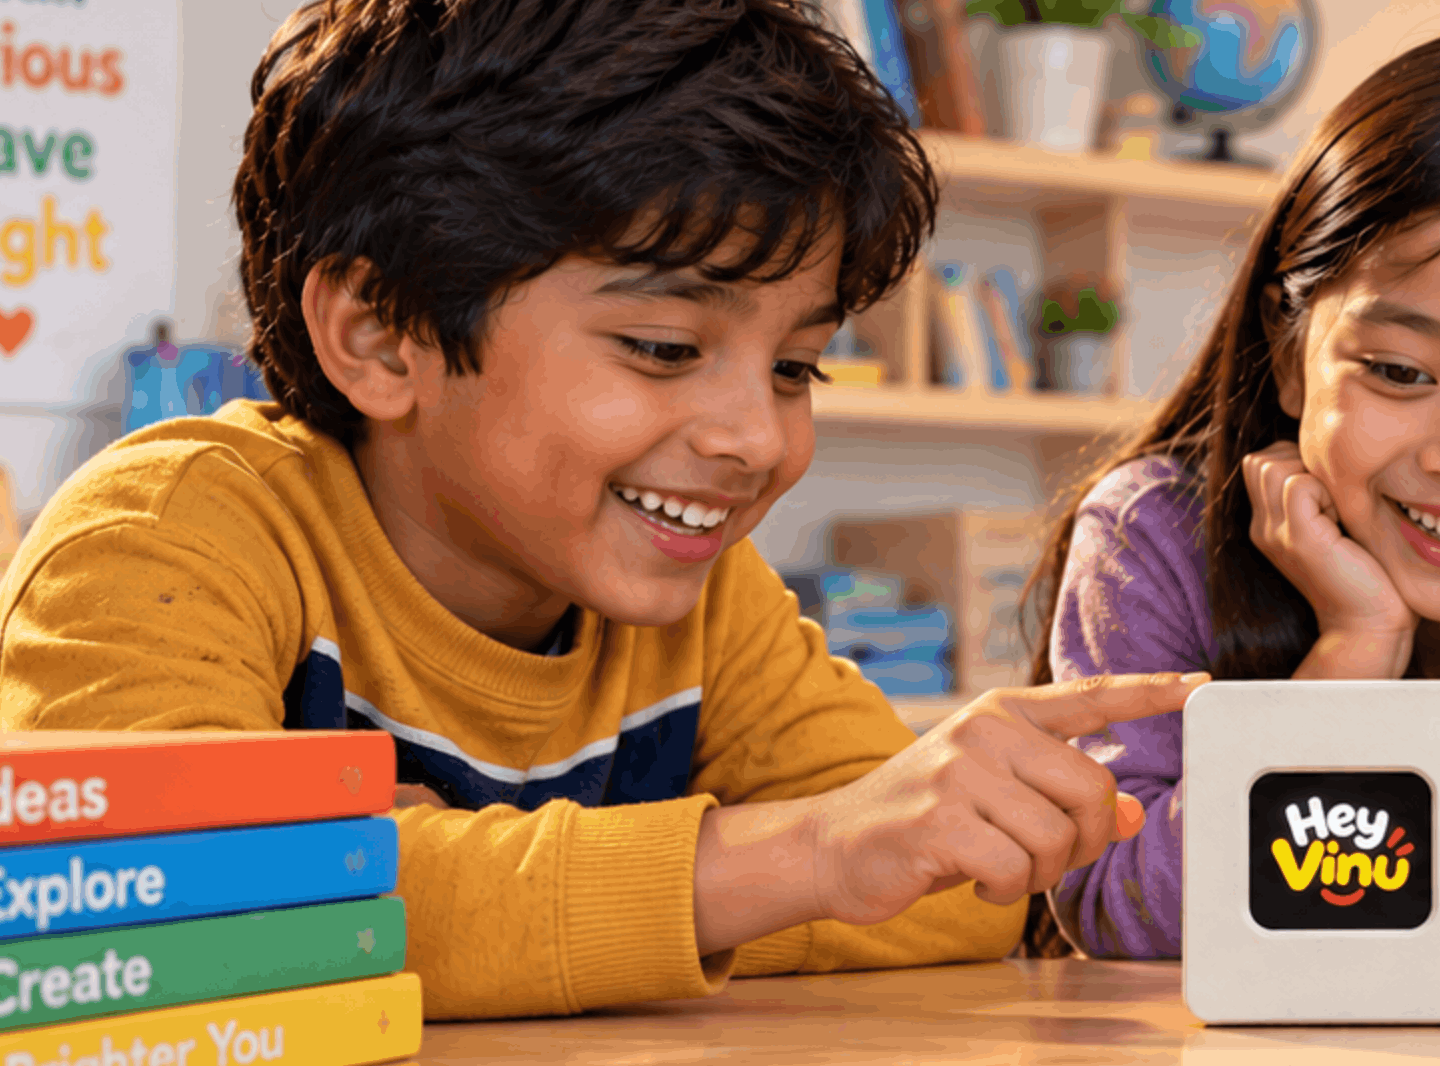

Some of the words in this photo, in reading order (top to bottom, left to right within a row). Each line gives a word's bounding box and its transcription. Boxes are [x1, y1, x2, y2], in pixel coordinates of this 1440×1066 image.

[0, 20, 126, 98] ious
[0, 194, 110, 286] ght
[1285, 796, 1389, 850] Hey
[0, 856, 165, 931] xplore
[1271, 837, 1411, 892] Vinu
[206, 1018, 284, 1066] You
